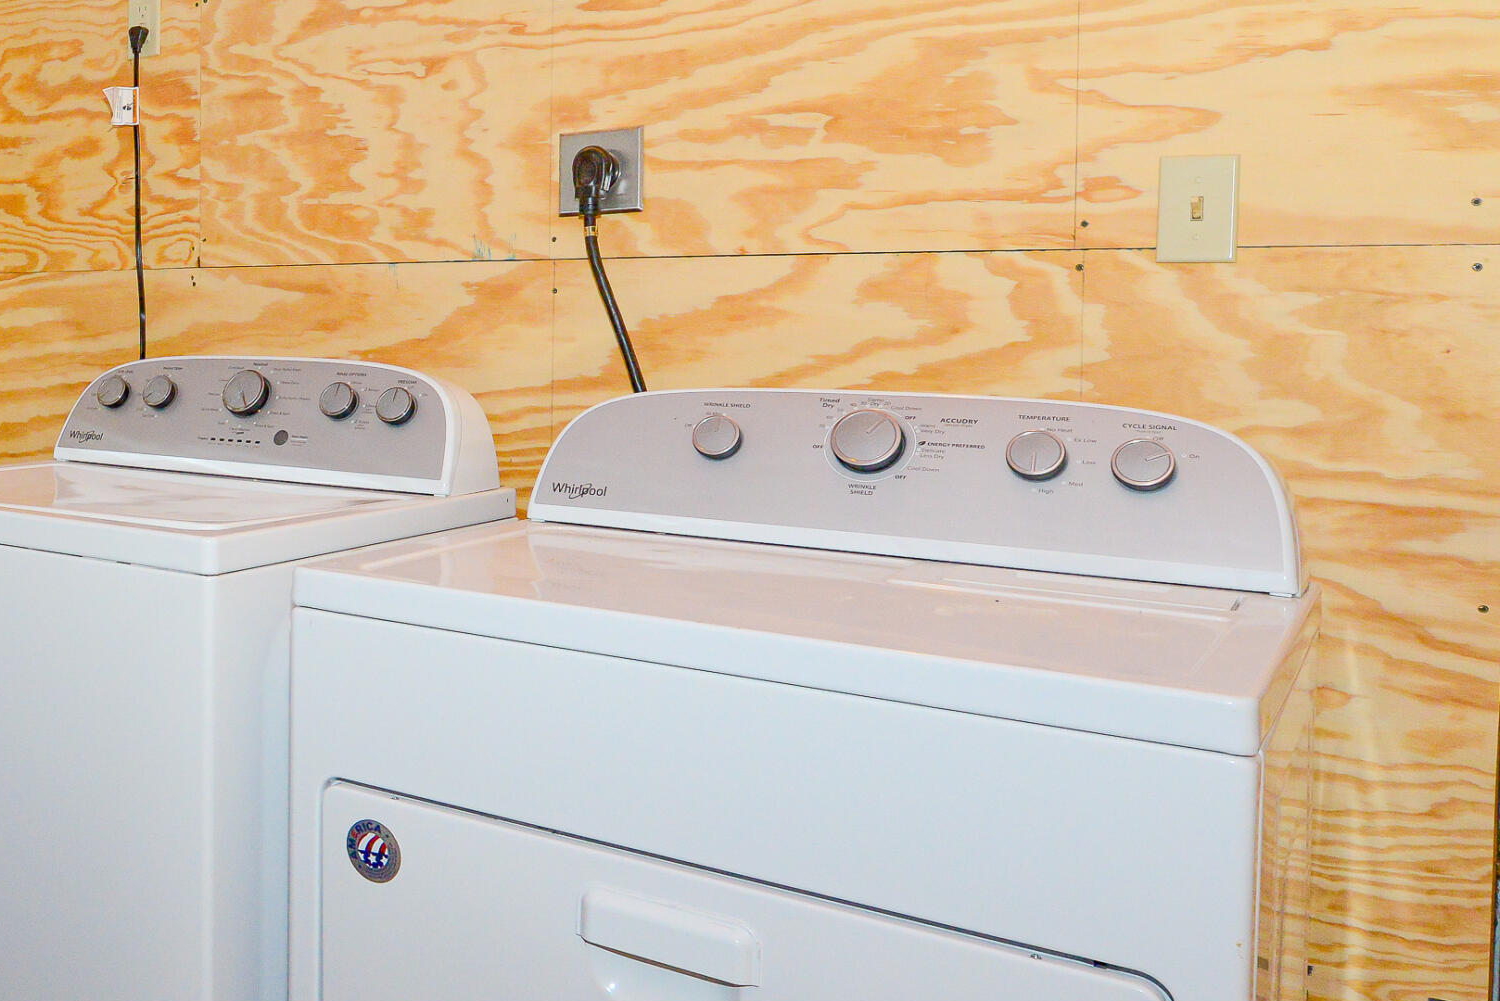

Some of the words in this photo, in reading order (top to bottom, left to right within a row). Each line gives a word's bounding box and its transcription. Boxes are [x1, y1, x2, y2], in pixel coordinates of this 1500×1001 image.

[1018, 414, 1070, 422] TEMPERATURE
[69, 430, 104, 443] Whirlpool
[552, 482, 607, 499] Whirlpool
